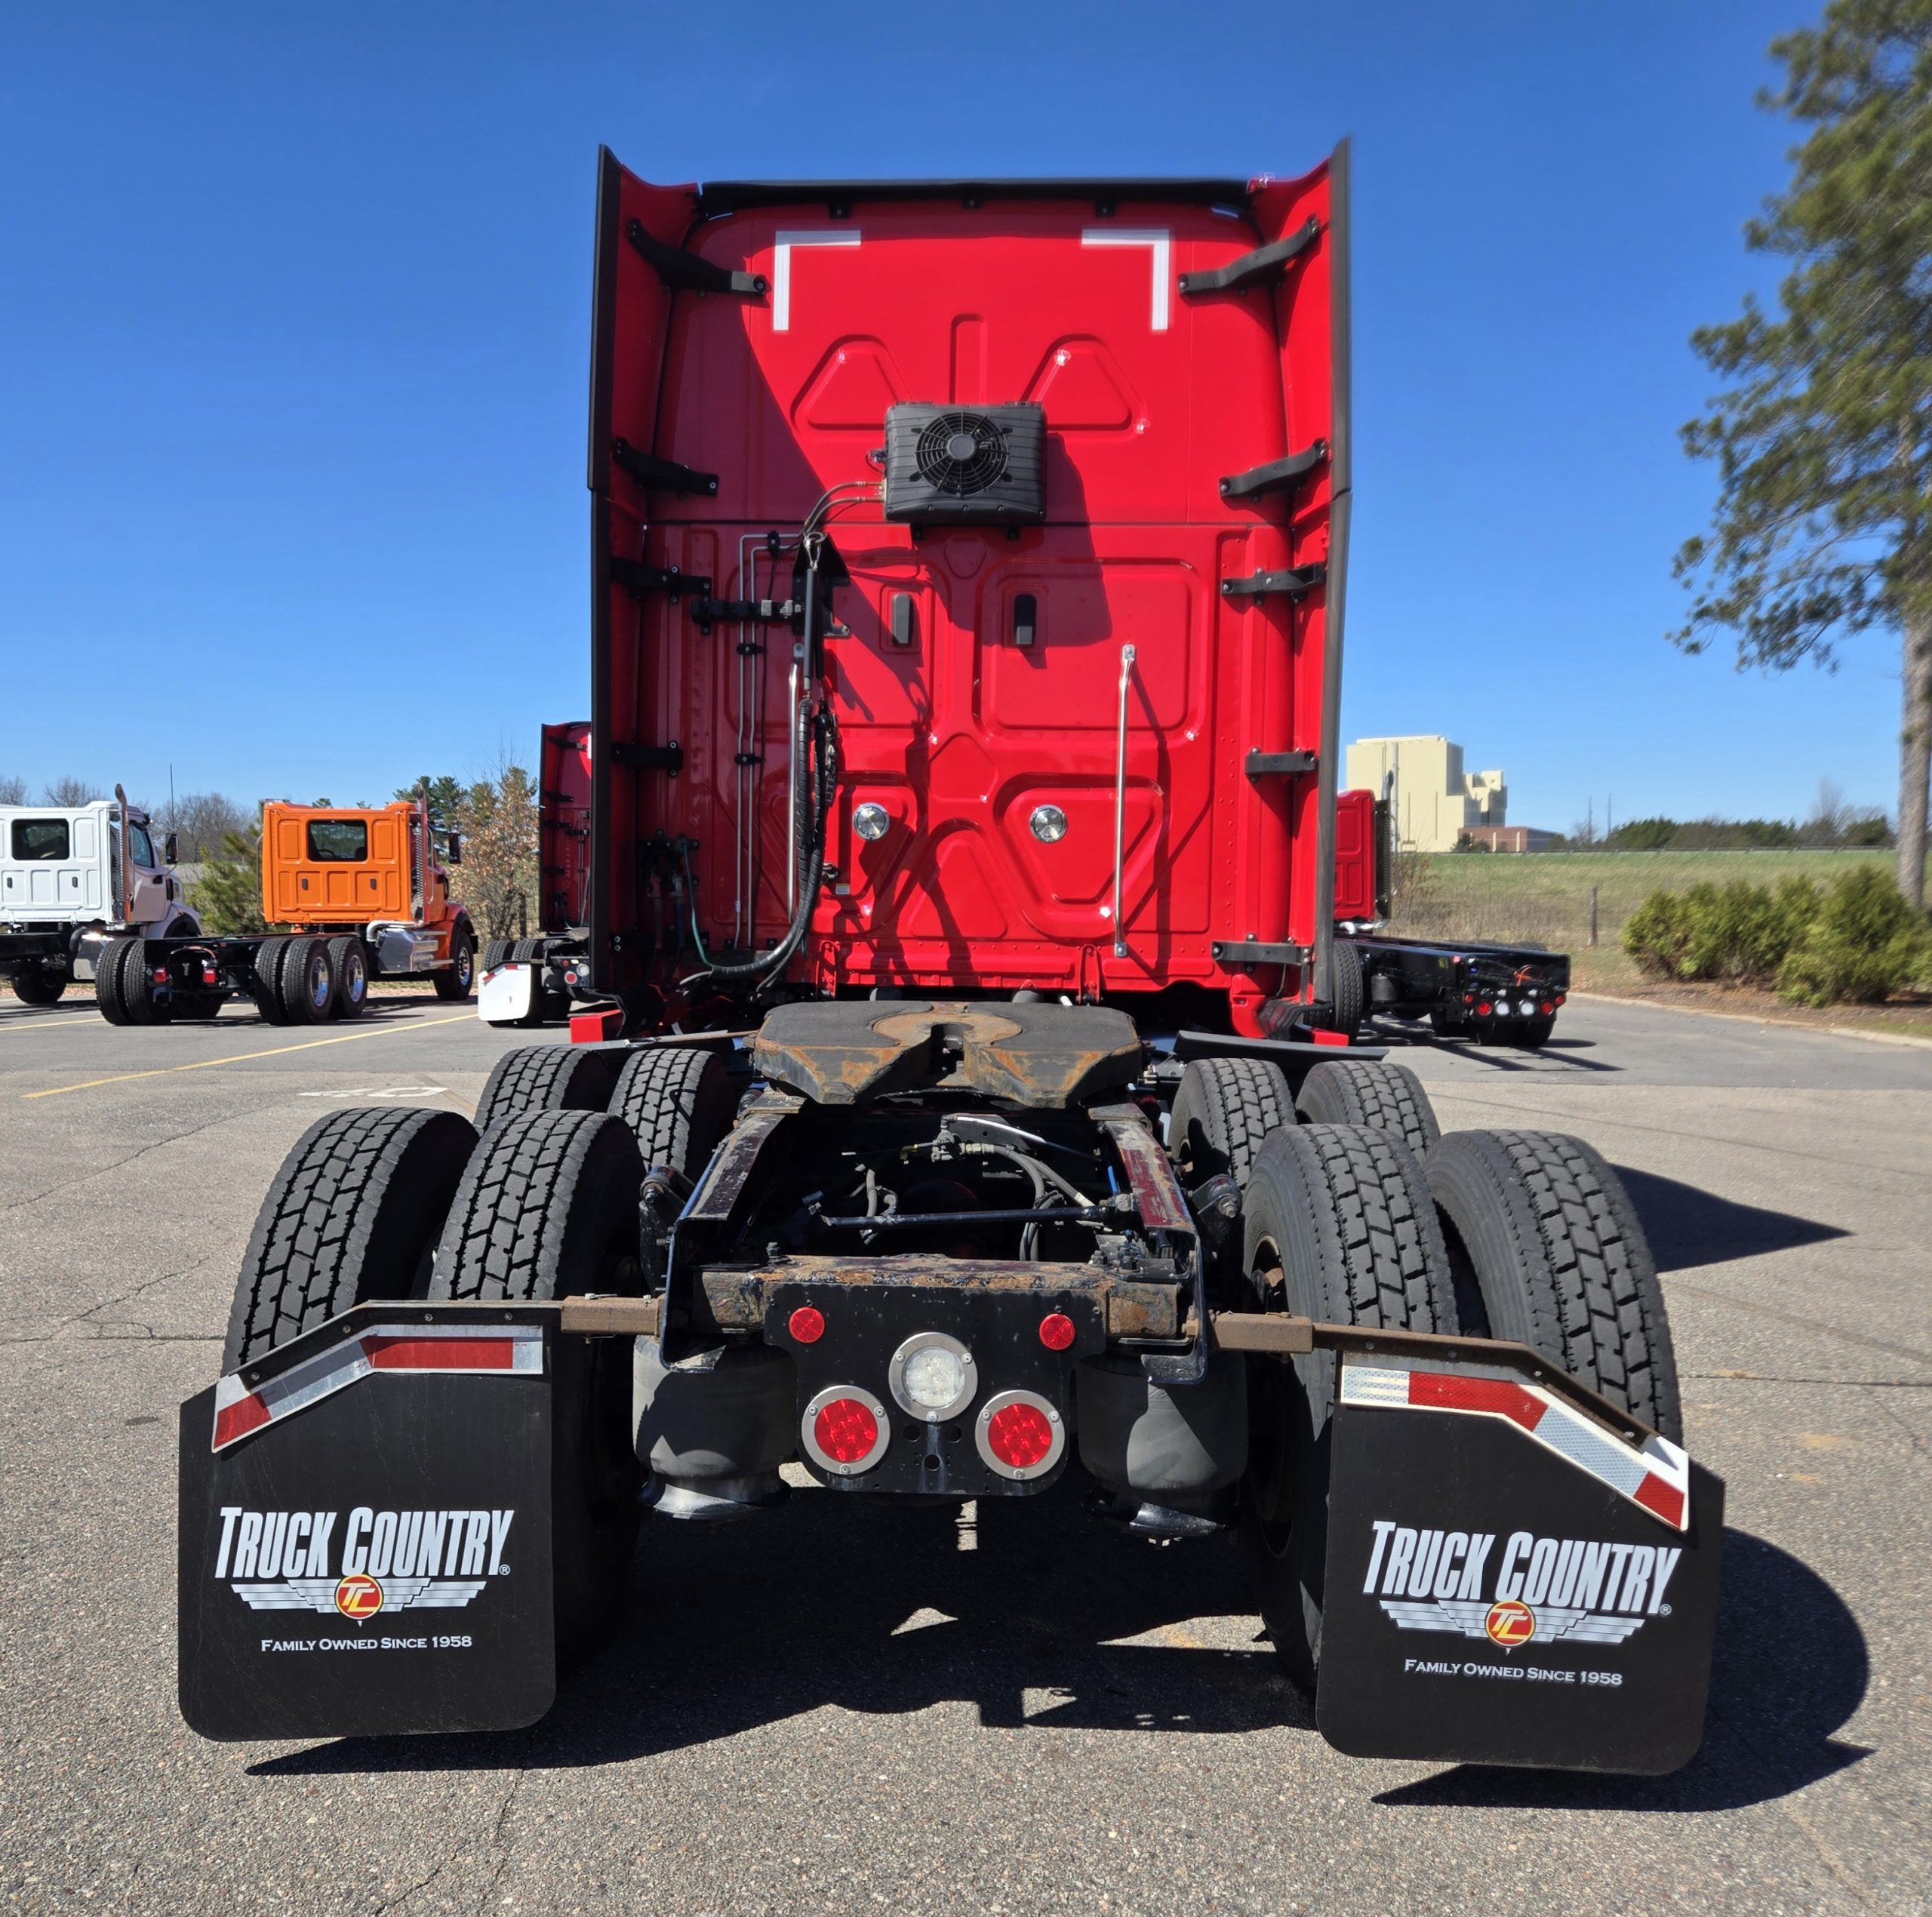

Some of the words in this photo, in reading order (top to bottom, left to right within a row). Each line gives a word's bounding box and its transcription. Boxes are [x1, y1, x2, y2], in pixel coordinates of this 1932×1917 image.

[214, 1506, 337, 1579] TRUCK
[1362, 1520, 1497, 1601] TRUCK
[261, 1639, 316, 1651] FAMILY
[318, 1639, 378, 1651] OWNED
[380, 1637, 428, 1649] SINCE
[432, 1635, 472, 1648] 1958
[1404, 1658, 1462, 1675] FAMILY
[1463, 1663, 1524, 1679] OWNED
[1527, 1667, 1576, 1682] SINCE
[1580, 1671, 1623, 1685] 1958
